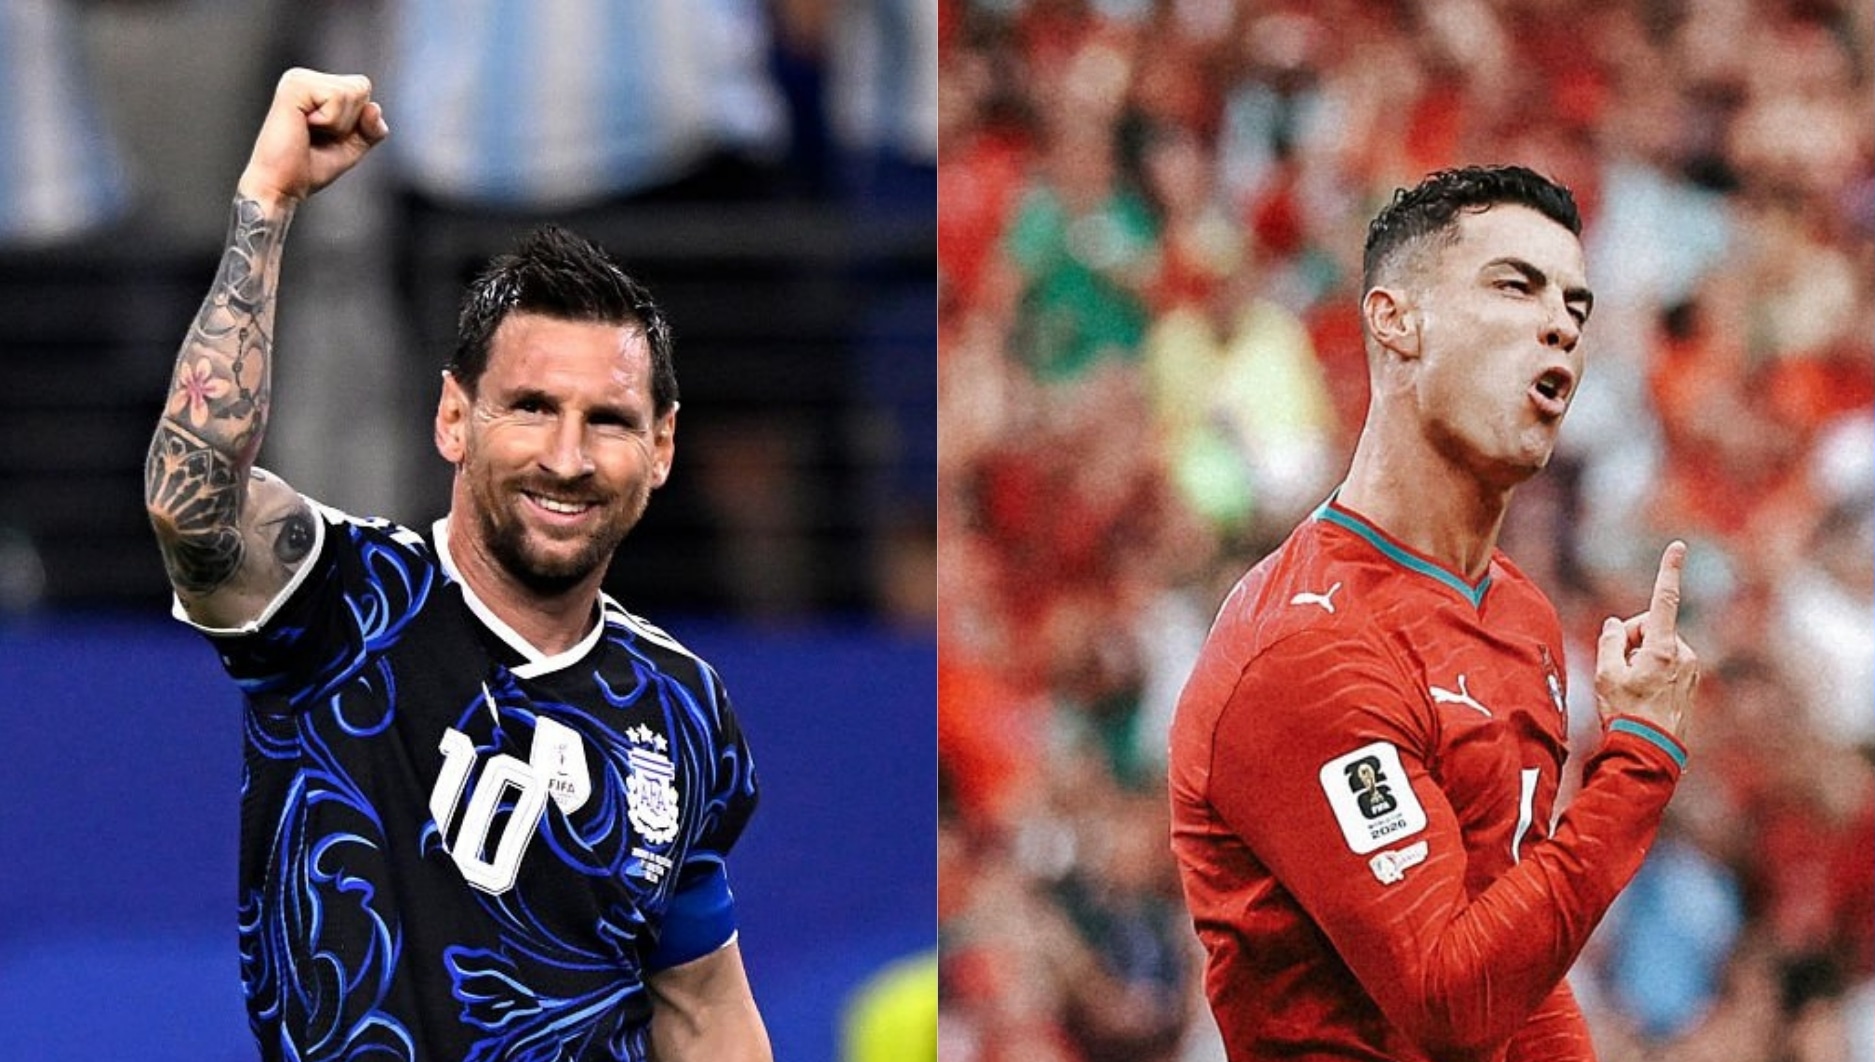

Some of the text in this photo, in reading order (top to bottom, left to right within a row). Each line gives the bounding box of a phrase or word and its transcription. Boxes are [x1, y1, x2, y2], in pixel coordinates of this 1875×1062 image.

[548, 778, 575, 793] FIFA
[429, 727, 548, 895] 10
[1370, 819, 1406, 839] 2026
